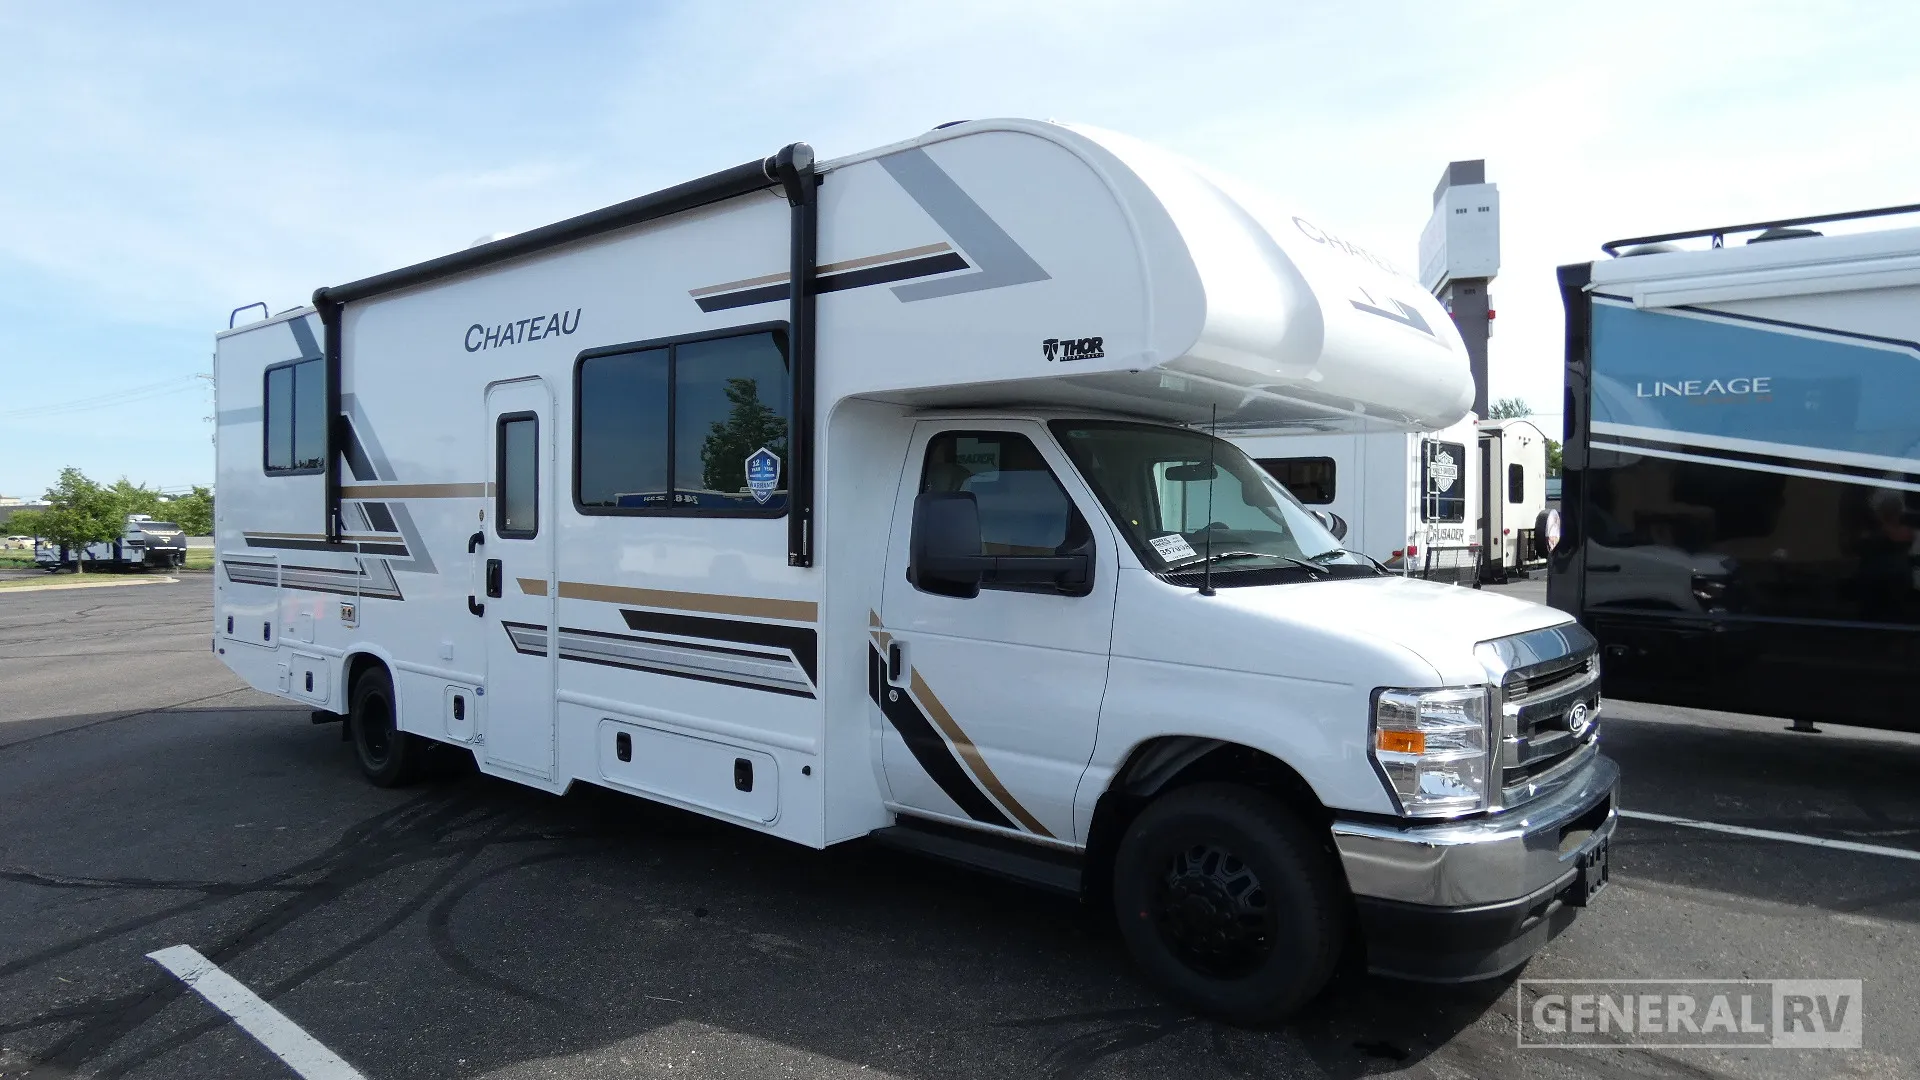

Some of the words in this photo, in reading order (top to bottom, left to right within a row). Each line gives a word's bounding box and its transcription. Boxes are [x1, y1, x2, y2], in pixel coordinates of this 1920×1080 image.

[464, 308, 582, 353] CHATEAU
[1060, 336, 1104, 356] THOR
[1637, 376, 1772, 397] LINEAGE
